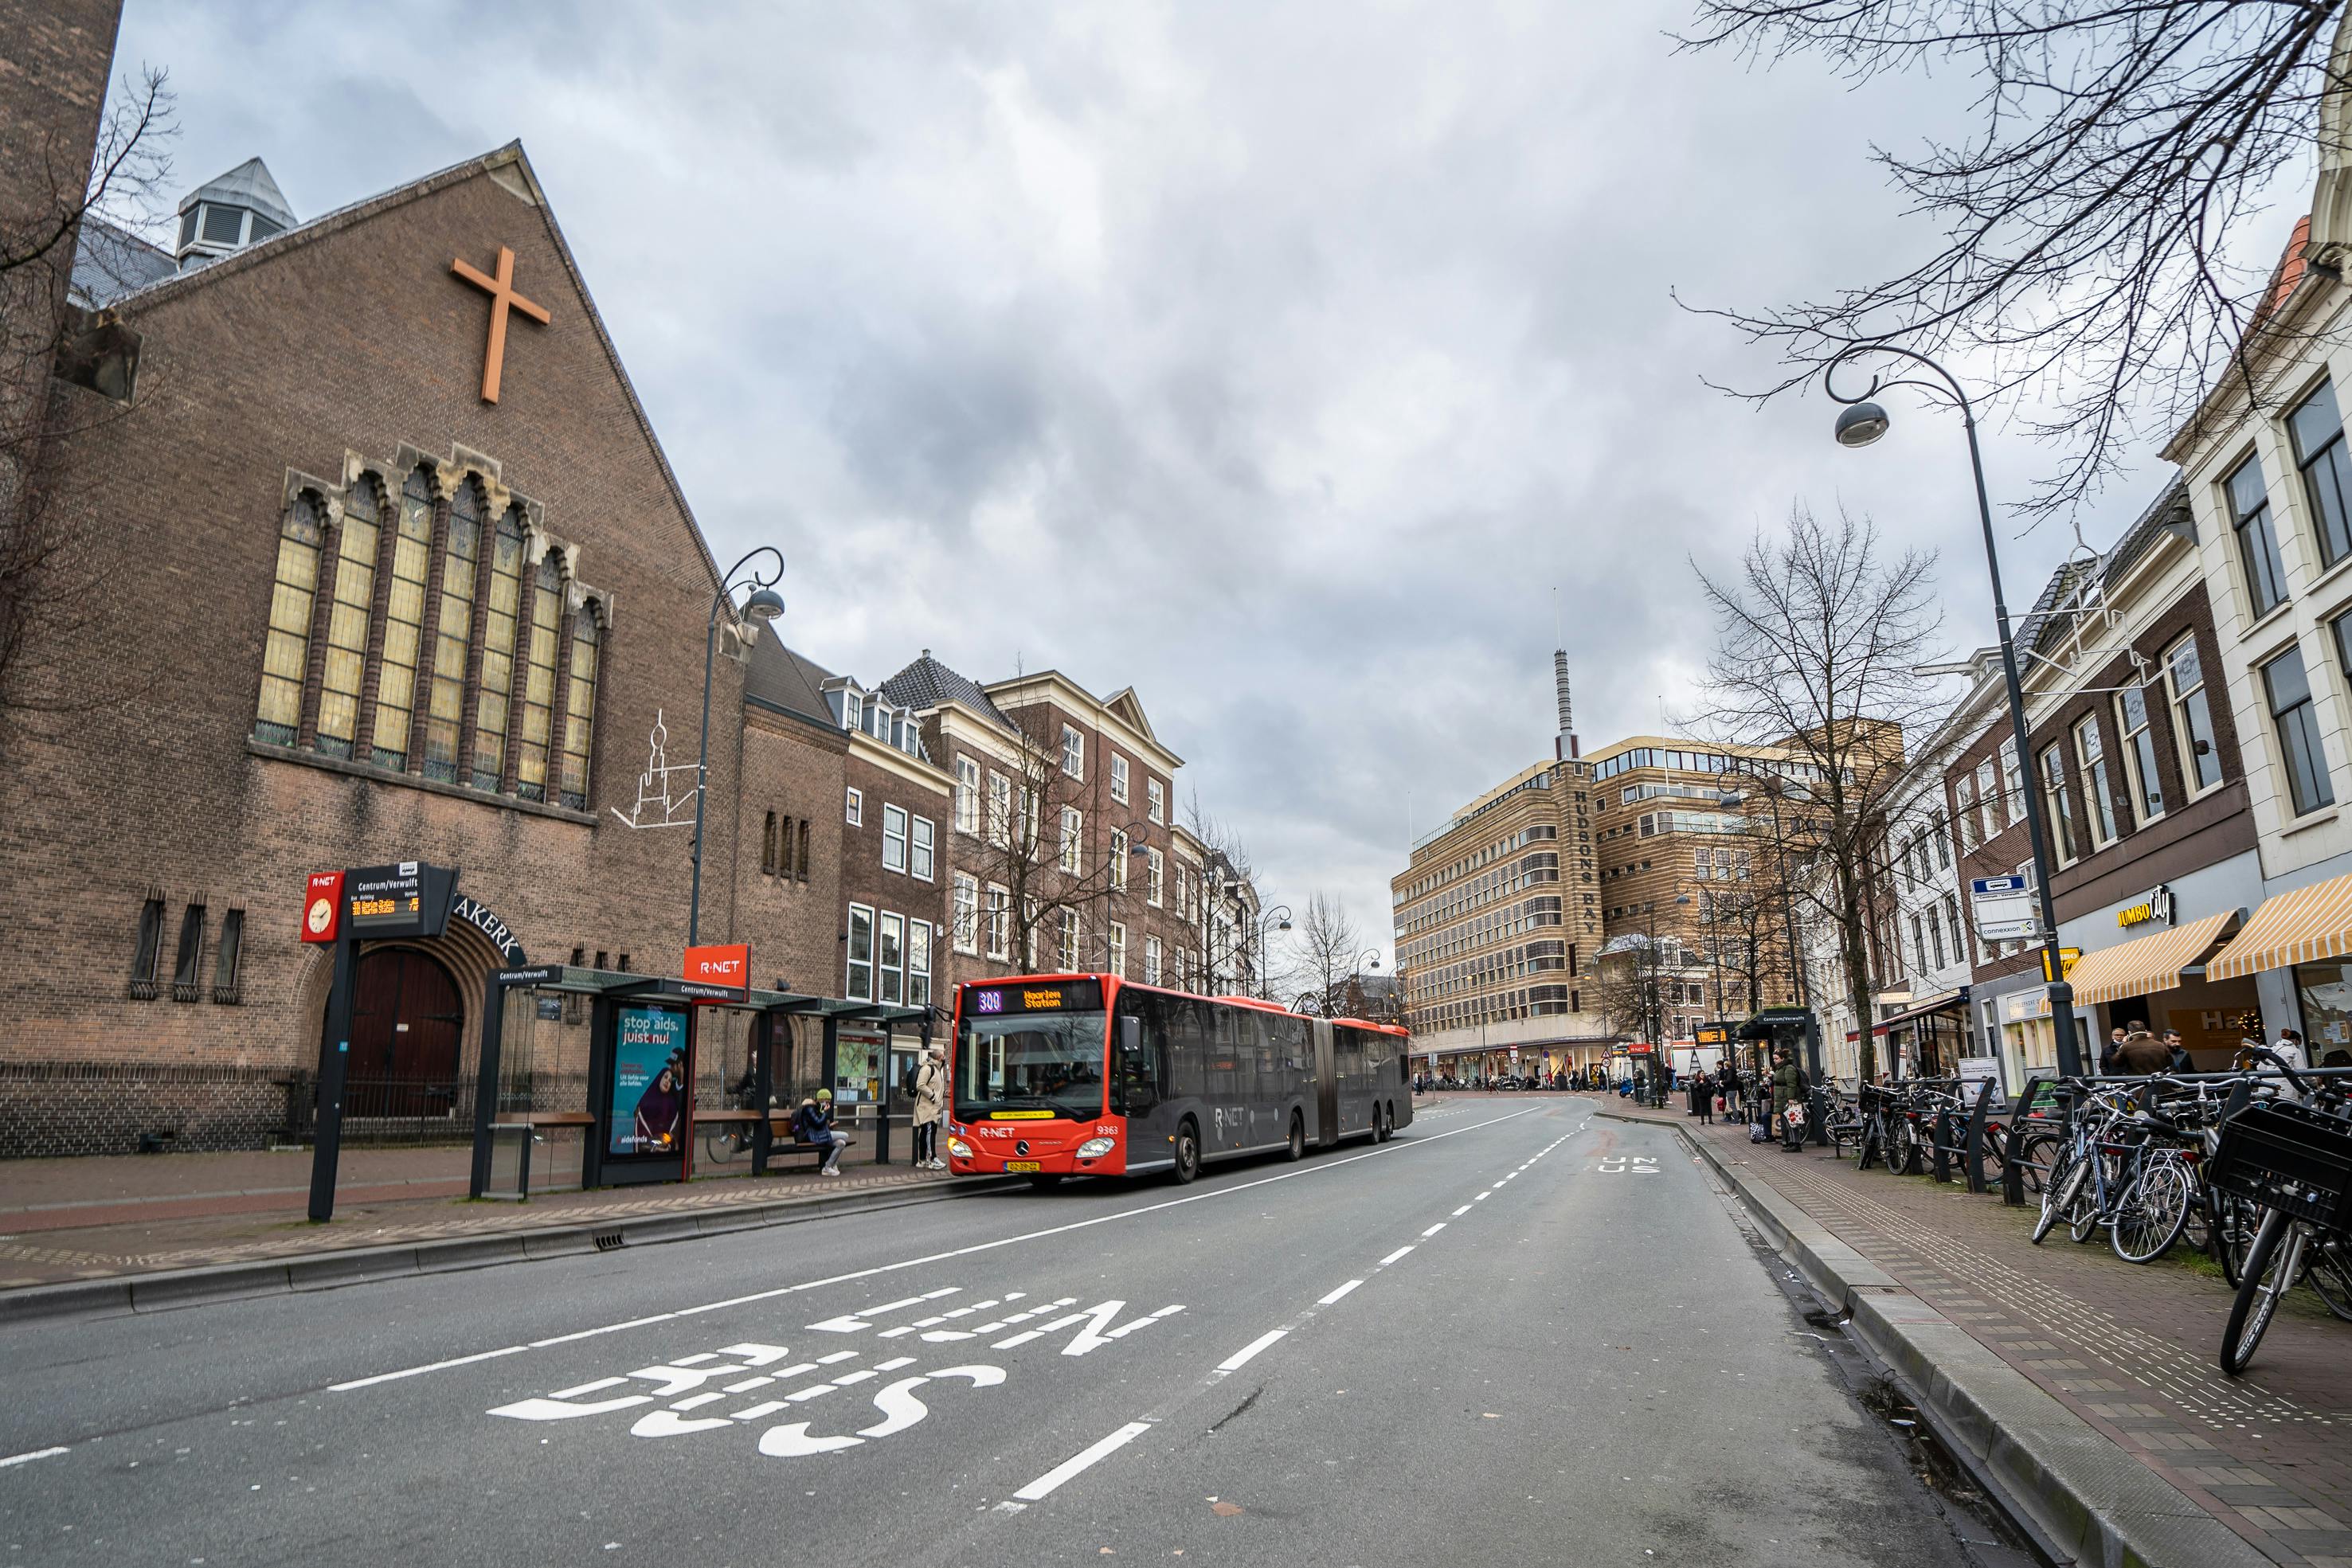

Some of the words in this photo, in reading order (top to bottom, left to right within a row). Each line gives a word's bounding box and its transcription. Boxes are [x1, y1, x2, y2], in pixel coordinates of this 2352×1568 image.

[1575, 791, 1592, 883] HUDSONS
[358, 878, 417, 892] Centrum/Verwulft
[1583, 893, 1596, 933] BAY
[2118, 904, 2150, 928] JUMBO
[499, 969, 548, 980] Centrum/Verwulft
[681, 985, 728, 998] Centrum/Verwulft
[980, 991, 1000, 1011] 300
[1025, 999, 1061, 1008] Station
[624, 1016, 651, 1030] stop
[623, 1030, 649, 1046] juist
[652, 1032, 670, 1045] nu!
[1098, 1126, 1118, 1135] 9363
[621, 1135, 648, 1144] aidsfonds
[486, 1343, 1007, 1457] BUS
